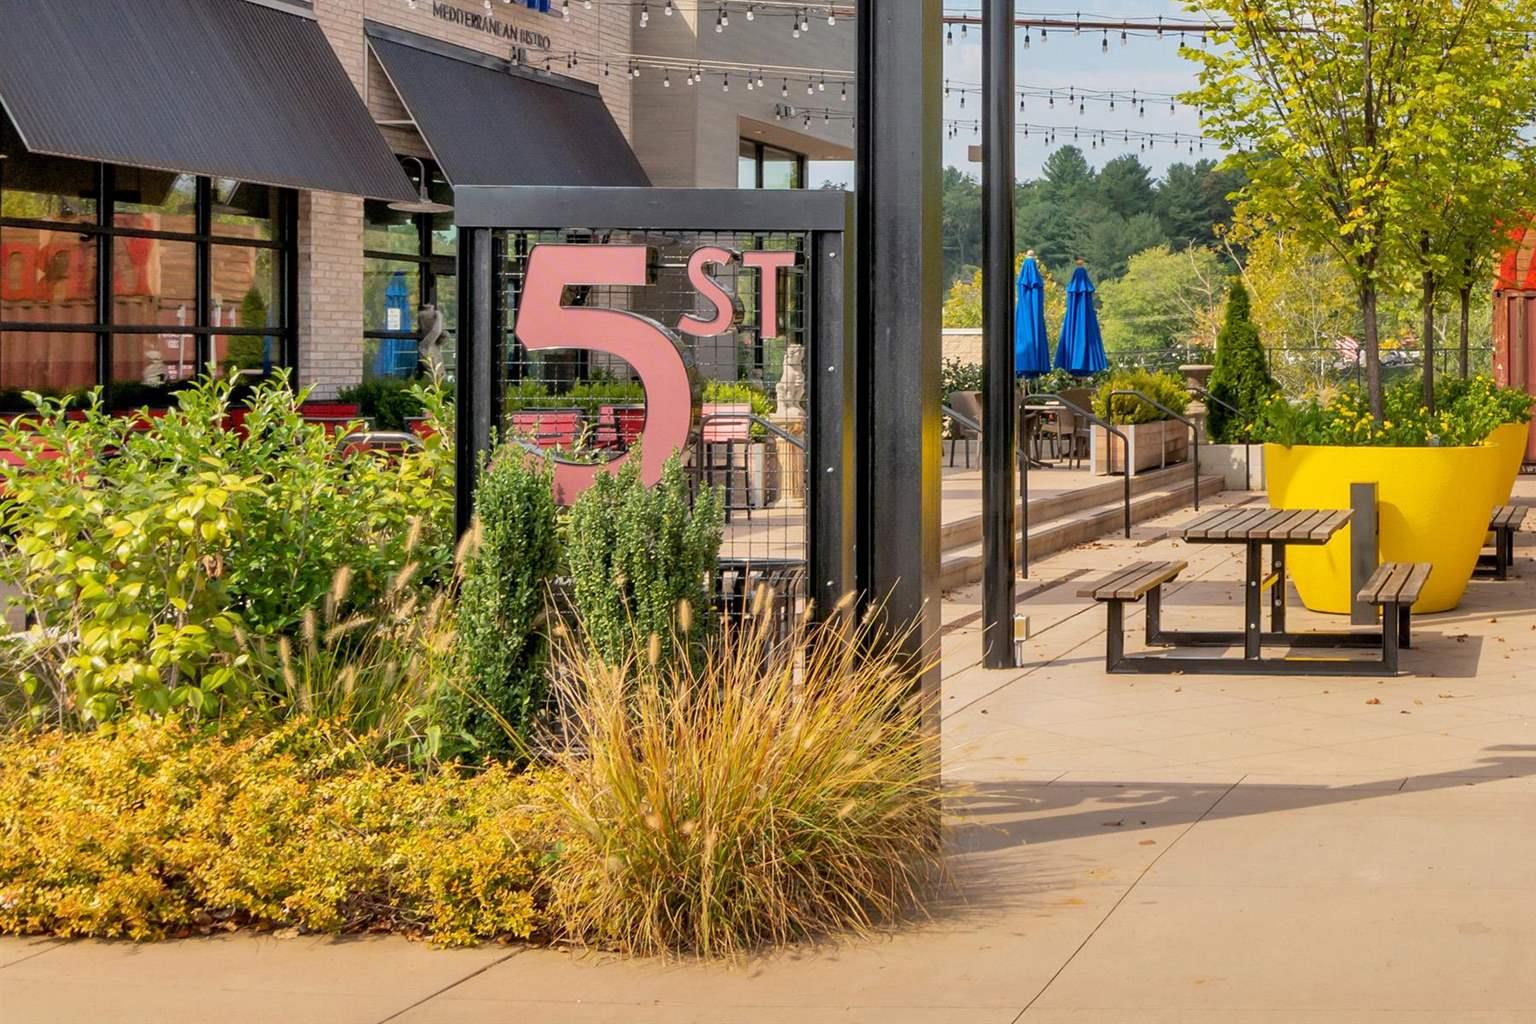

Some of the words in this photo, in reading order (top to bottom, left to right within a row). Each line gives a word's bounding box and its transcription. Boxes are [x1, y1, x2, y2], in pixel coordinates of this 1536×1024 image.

[432, 0, 518, 42] MEDITERRANEAN
[519, 30, 551, 50] BISTRO
[487, 243, 695, 507] 5
[677, 245, 798, 339] ST
